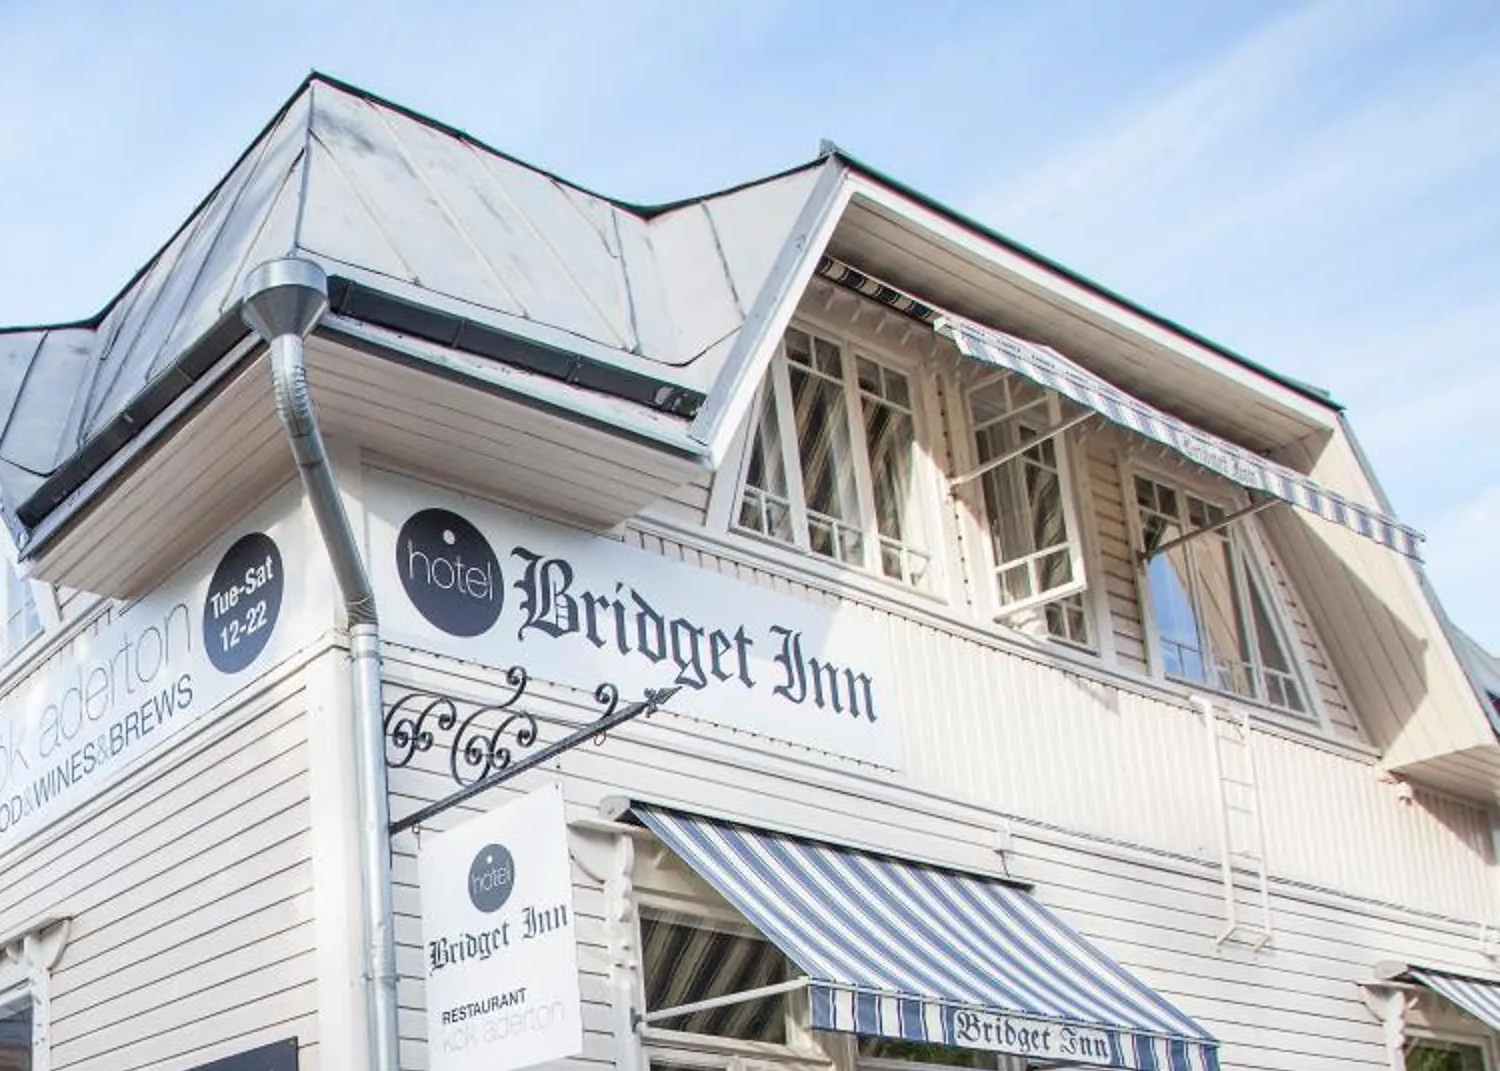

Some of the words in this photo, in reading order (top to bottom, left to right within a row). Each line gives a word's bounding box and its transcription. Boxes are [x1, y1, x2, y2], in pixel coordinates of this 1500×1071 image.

[210, 555, 274, 620] Tue-Sat
[407, 539, 492, 602] hotel
[219, 601, 268, 652] 12-22
[510, 544, 756, 690] Bridget
[769, 623, 878, 723] Inn
[471, 861, 511, 896] hotel
[429, 919, 510, 977] Bridget
[521, 903, 568, 940] Inn
[441, 987, 528, 1026] RESTAURANT
[956, 1009, 1051, 1053] Bridget
[1059, 1027, 1109, 1059] Inn
